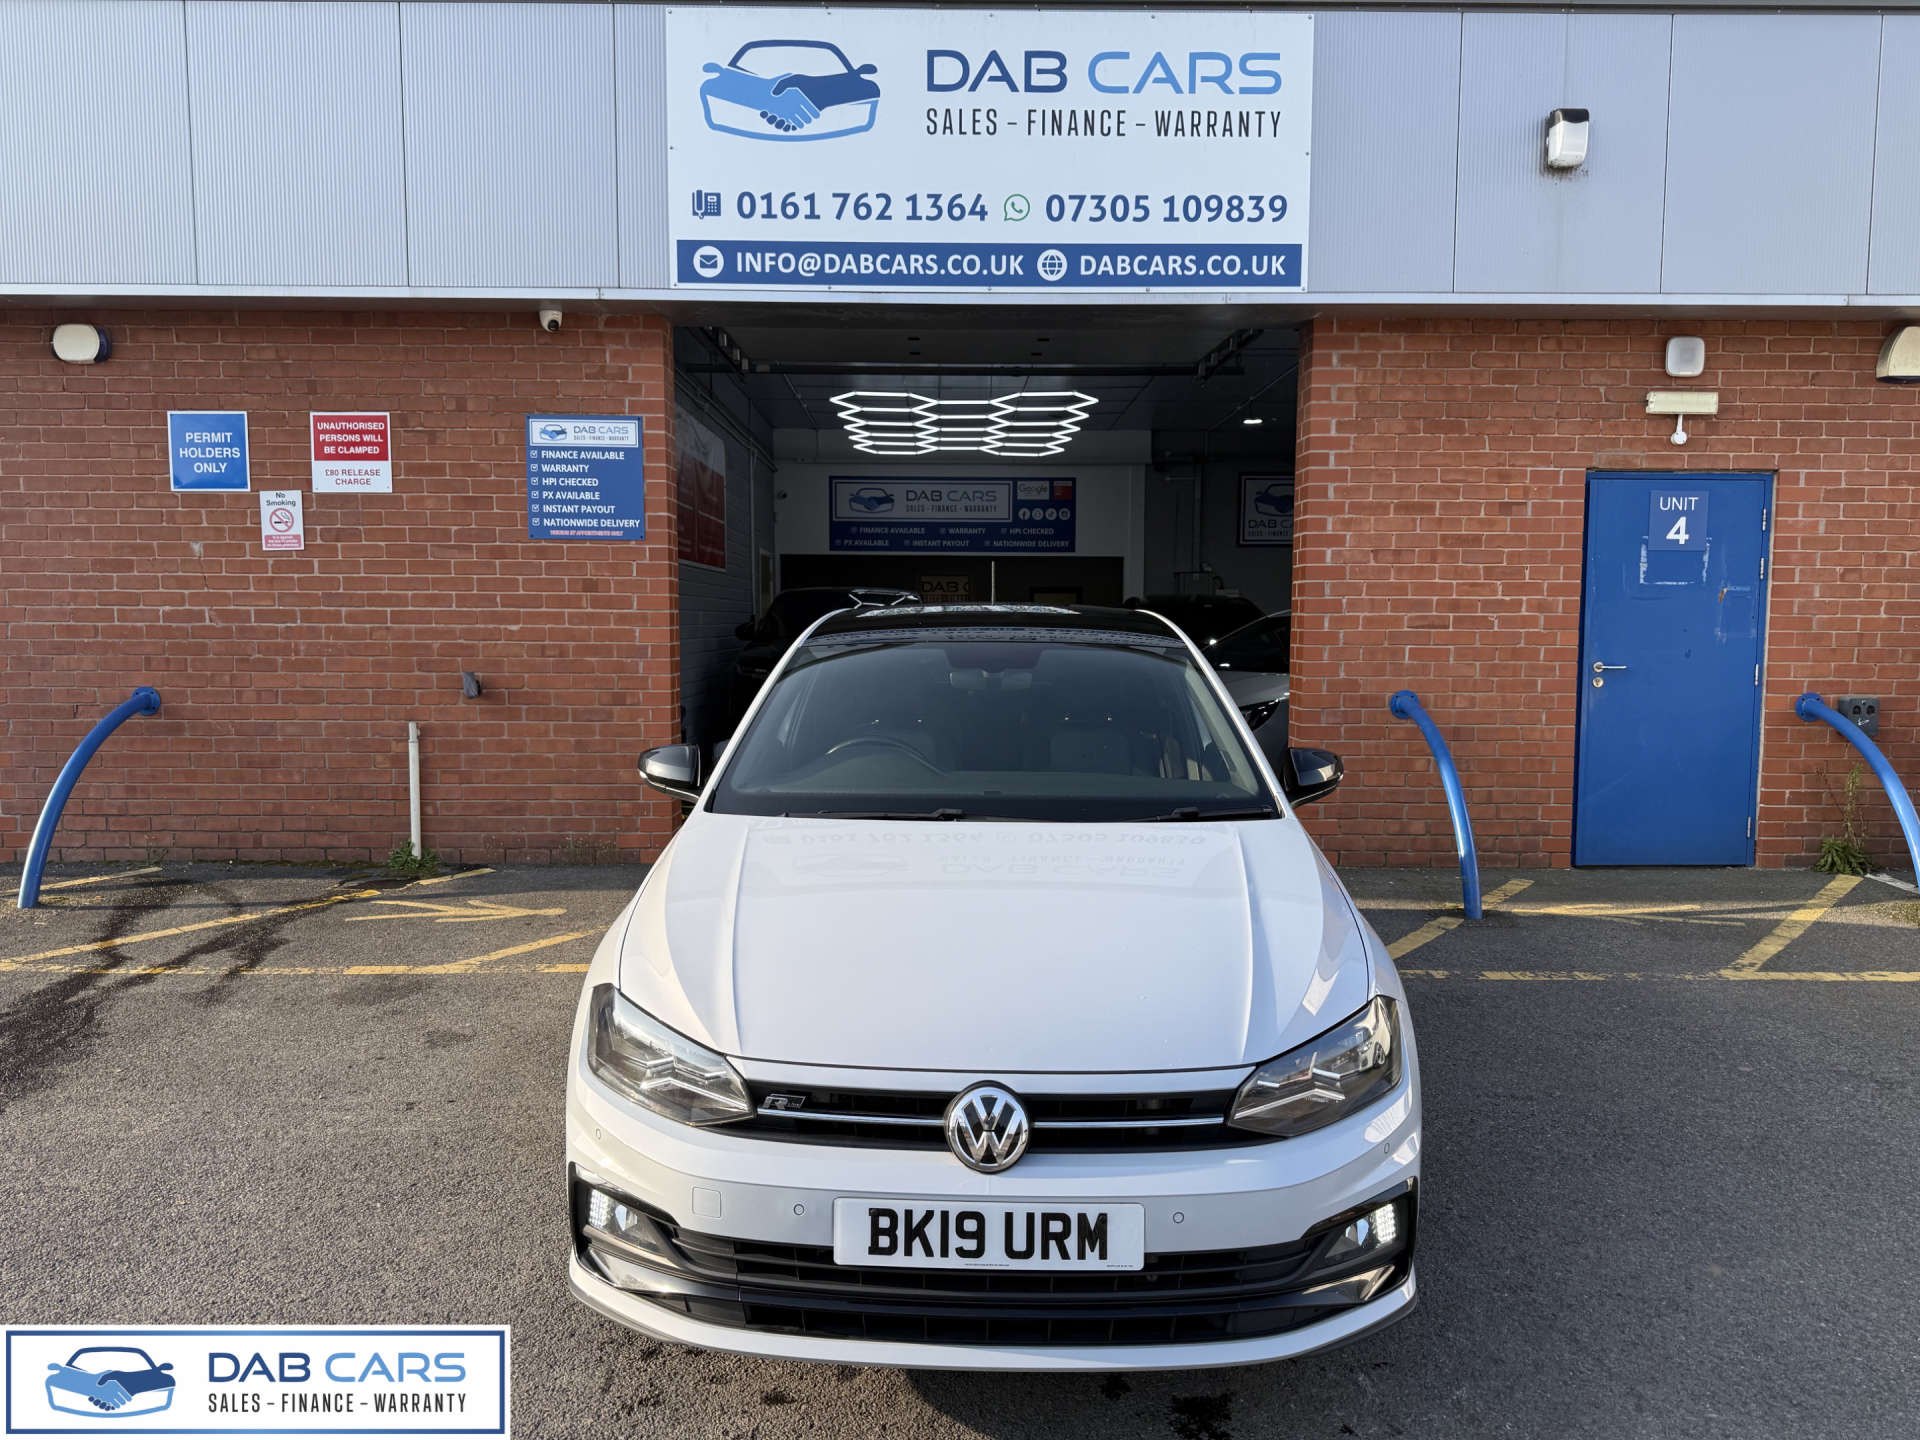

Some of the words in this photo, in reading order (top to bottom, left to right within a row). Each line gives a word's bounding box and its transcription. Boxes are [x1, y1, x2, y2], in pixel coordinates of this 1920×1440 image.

[926, 49, 1068, 93] DAB
[1088, 51, 1283, 95] CARS
[926, 108, 998, 136] SALES
[1026, 109, 1127, 137] FINANCE
[1154, 110, 1282, 138] WARRANTY
[736, 191, 821, 221] 0161
[831, 192, 893, 222] 762
[905, 192, 989, 222] 1364
[1045, 193, 1150, 223] 07305
[1163, 194, 1288, 224] 109839
[735, 251, 1024, 278] INFO@DABCARS.CO.UK
[1079, 253, 1286, 278] DABCARS.CO.UK
[317, 422, 385, 431] UNAUTHORISED
[573, 425, 596, 434] DAB
[598, 426, 629, 435] CARS
[185, 432, 232, 444] PERMIT
[319, 434, 361, 443] PERSONS
[362, 434, 383, 443] WILL
[179, 447, 241, 459] HOLDERS
[324, 446, 337, 455] BE
[337, 446, 380, 455] CLAMPED
[541, 450, 578, 459] FINANCE
[580, 451, 625, 460] AVAILABLE
[193, 462, 228, 474] ONLY
[325, 469, 340, 477] £80
[341, 469, 381, 477] RELEASE
[541, 464, 589, 473] WARRANTY
[335, 478, 371, 486] CHARGE
[542, 477, 557, 486] HPI
[558, 478, 599, 487] CHECKED
[542, 490, 554, 499] PX
[555, 491, 600, 500] AVAILABLE
[905, 489, 943, 502] DAB
[946, 490, 997, 502] CARS
[266, 499, 296, 508] Smoking
[1659, 496, 1699, 511] UNIT
[543, 504, 579, 513] INSTANT
[581, 505, 616, 514] PAYOUT
[543, 518, 599, 527] NATIONWIDE
[600, 519, 640, 528] DELIVERY
[859, 526, 889, 534] FINANCE
[890, 527, 925, 535] AVAILABLE
[948, 527, 986, 535] WARRANTY
[1022, 528, 1054, 536] CHECKED
[1666, 516, 1690, 545] 4
[854, 539, 889, 547] AVAILABLE
[942, 540, 969, 548] PAYOUT
[1037, 540, 1070, 548] DELIVERY
[867, 1208, 986, 1259] BK19
[1004, 1211, 1108, 1261] URM
